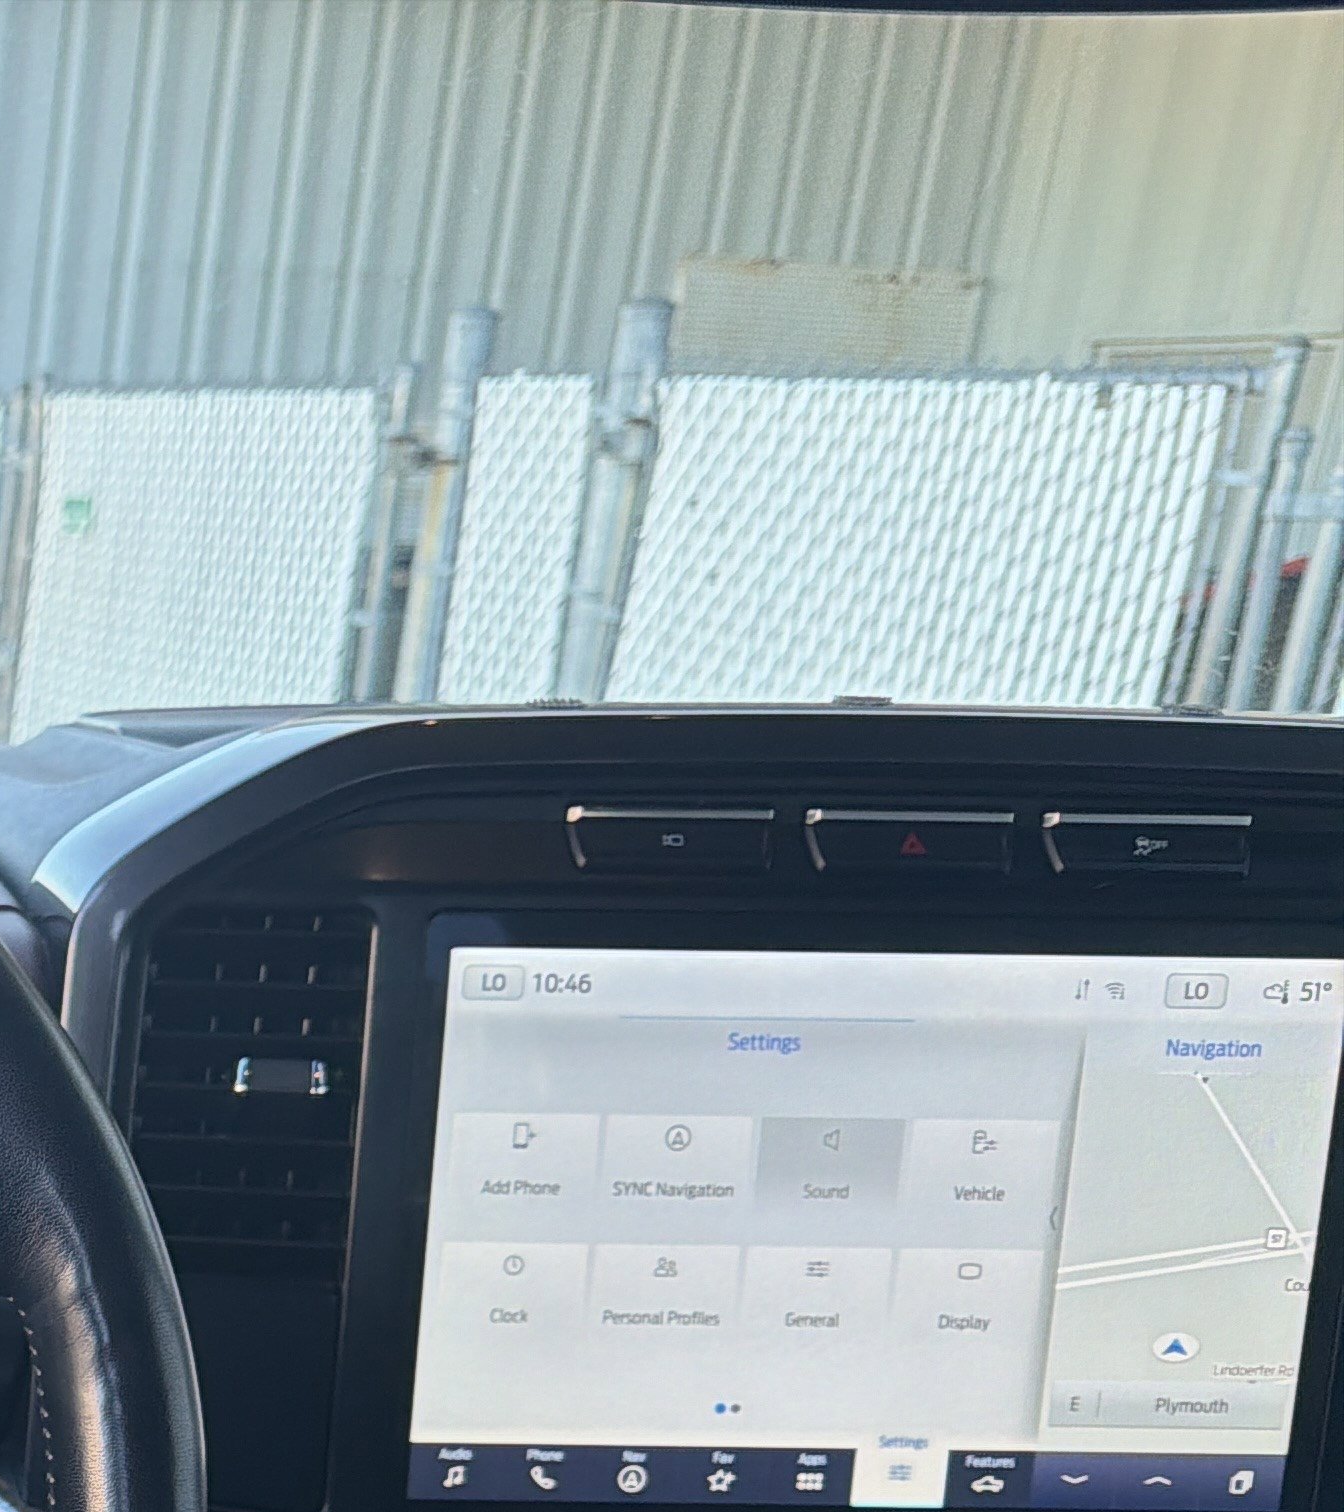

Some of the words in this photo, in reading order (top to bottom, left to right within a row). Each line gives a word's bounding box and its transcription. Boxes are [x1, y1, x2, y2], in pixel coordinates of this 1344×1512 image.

[481, 973, 506, 992] LO
[532, 973, 592, 994] 10:46
[1183, 981, 1209, 1000] LO
[1299, 982, 1333, 1002] 51°
[727, 1032, 801, 1055] Settings
[1166, 1039, 1262, 1061] Navigation
[481, 1180, 511, 1196] Add
[513, 1180, 561, 1197] Phone
[612, 1181, 653, 1197] SYNC
[656, 1181, 734, 1200] Navigation
[803, 1183, 850, 1200] Sound
[954, 1185, 1006, 1202] Vehicle
[489, 1307, 529, 1324] Clock
[602, 1309, 664, 1326] Personal
[667, 1310, 720, 1327] Profiles
[785, 1311, 840, 1328] General
[937, 1313, 991, 1332] Display
[1069, 1396, 1081, 1412] E
[1154, 1398, 1229, 1416] Plymouth
[878, 1435, 929, 1450] Settings
[438, 1448, 473, 1461] Audio
[525, 1448, 564, 1462] Phone
[622, 1450, 647, 1463] Nav
[712, 1450, 735, 1465] Fav
[965, 1455, 1016, 1469] Features
